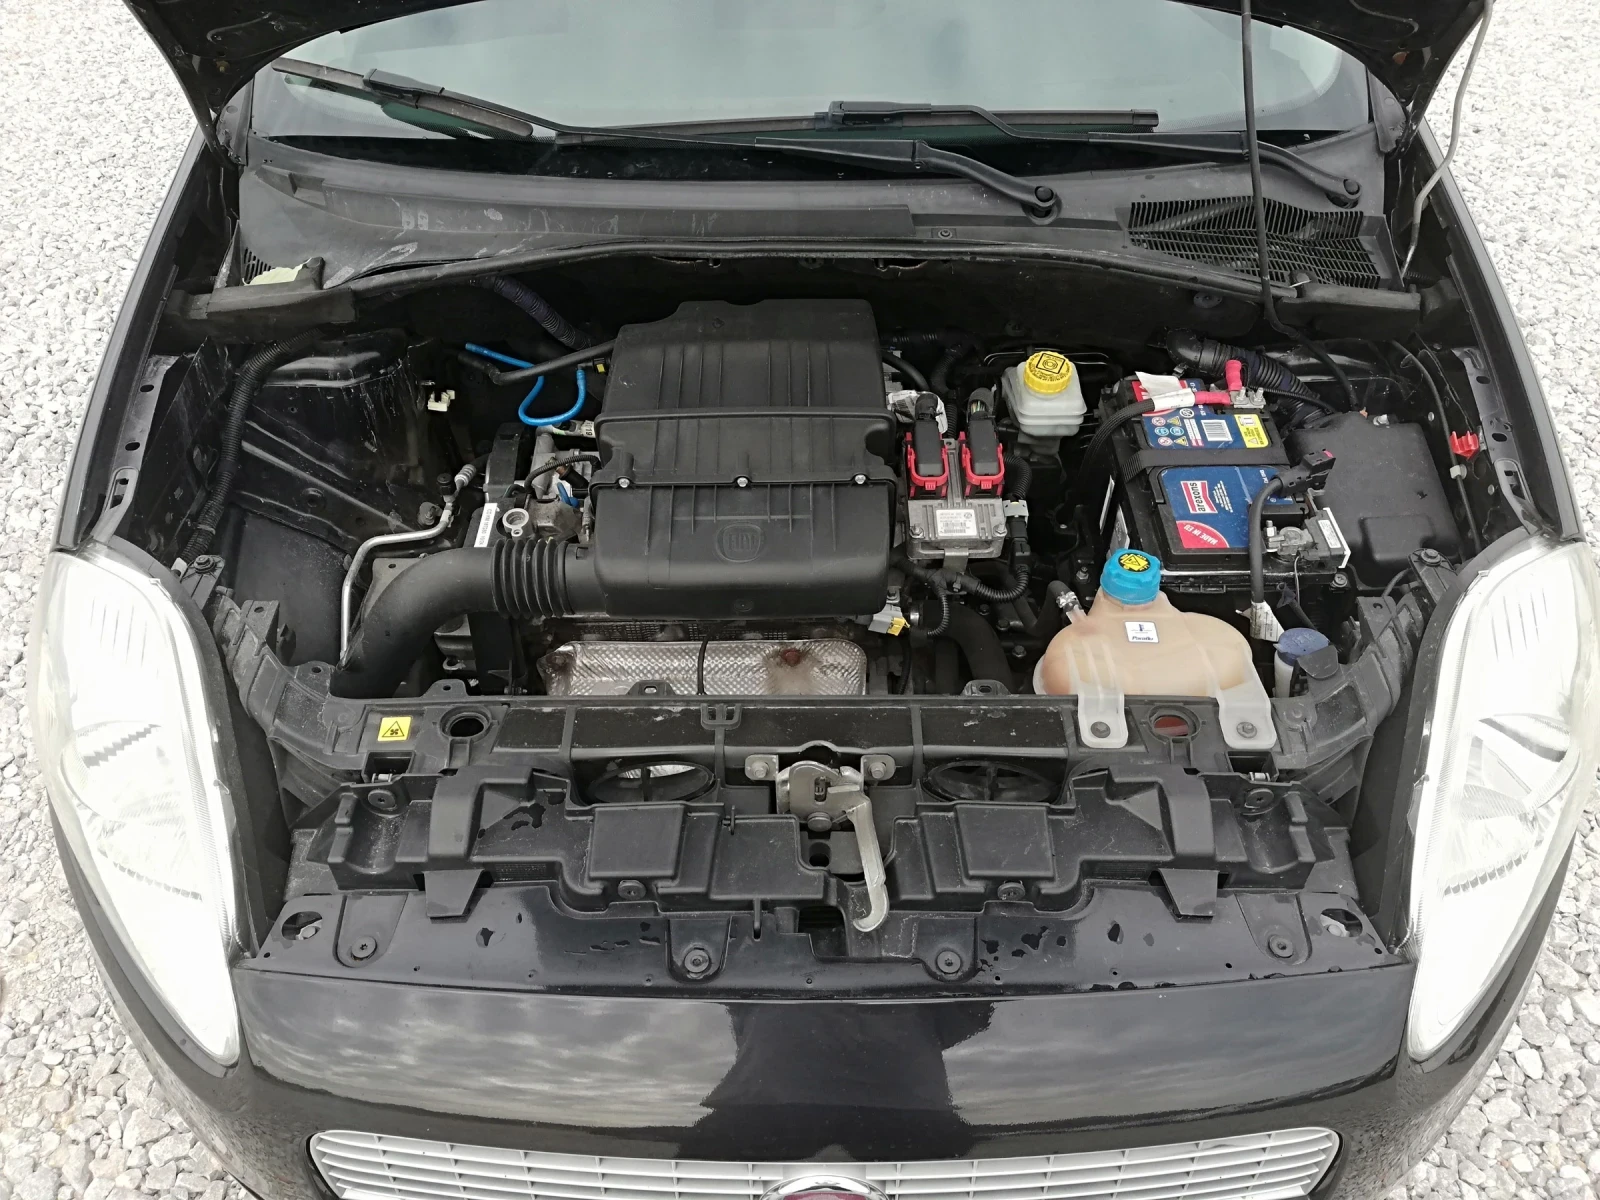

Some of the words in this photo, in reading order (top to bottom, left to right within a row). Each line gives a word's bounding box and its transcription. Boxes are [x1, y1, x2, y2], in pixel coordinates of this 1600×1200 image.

[1189, 482, 1206, 512] arexons
[1191, 528, 1202, 537] IN
[1200, 533, 1219, 545] MADE
